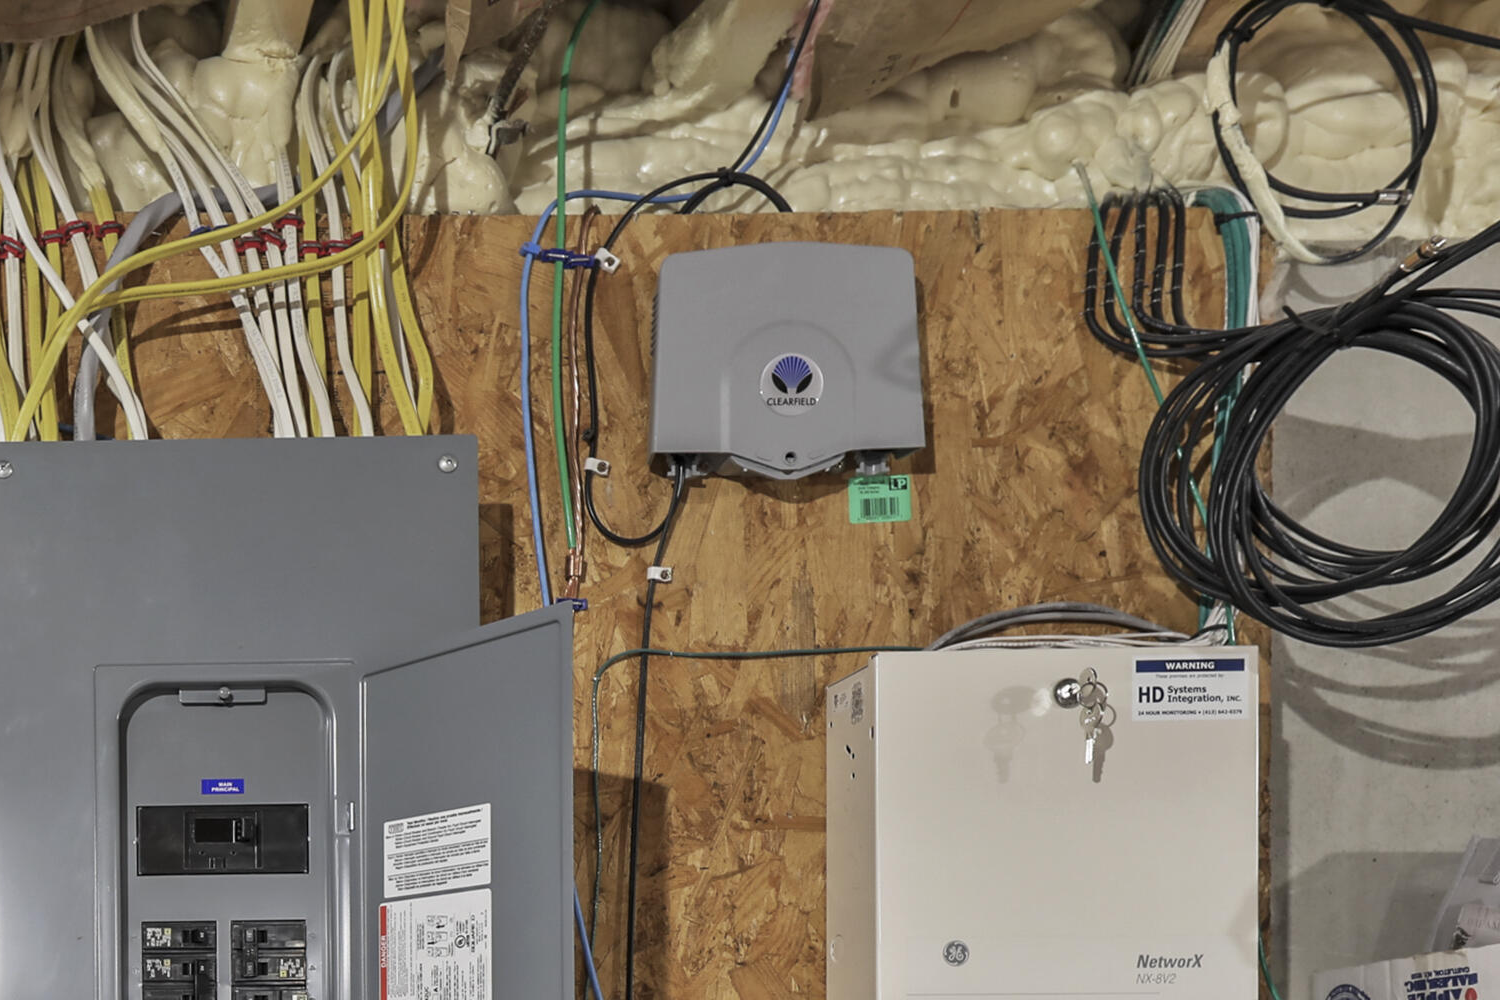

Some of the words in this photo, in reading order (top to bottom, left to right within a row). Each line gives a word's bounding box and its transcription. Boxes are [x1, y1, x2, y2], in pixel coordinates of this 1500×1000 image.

[766, 397, 817, 406] CLEARFIELD
[890, 478, 907, 490] LP
[1165, 661, 1216, 670] WARNING
[1138, 686, 1165, 704] HD
[1167, 685, 1207, 695] Systems
[1167, 694, 1224, 704] Integration,
[380, 935, 388, 968] DANGER
[1136, 954, 1204, 970] NetworX
[1136, 972, 1177, 985] NX-8V2
